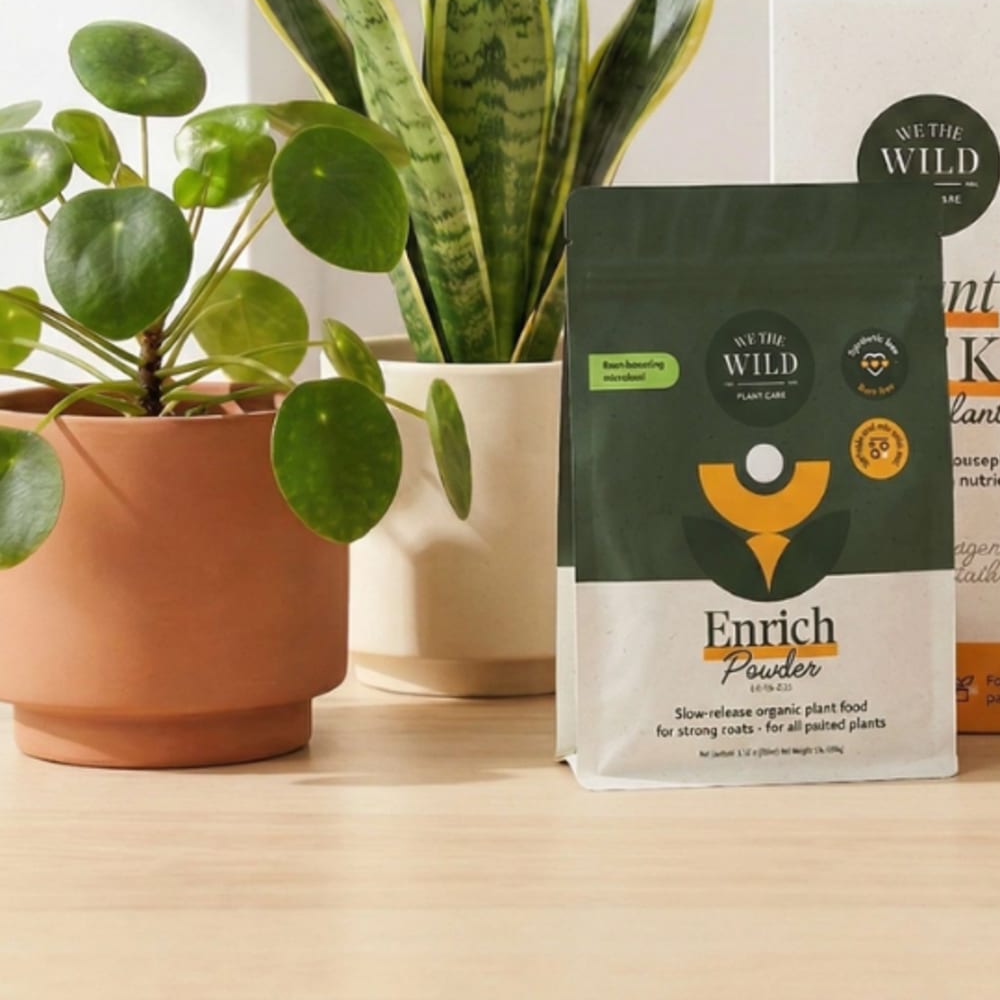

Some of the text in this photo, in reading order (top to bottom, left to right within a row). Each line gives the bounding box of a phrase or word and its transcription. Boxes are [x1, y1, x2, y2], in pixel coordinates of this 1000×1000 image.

[895, 121, 964, 142] WE THE
[880, 146, 980, 175] WILD
[758, 331, 787, 348] THE
[723, 352, 799, 376] WILD
[736, 390, 787, 401] PLANT CARE
[704, 605, 836, 649] Enrich
[720, 648, 822, 685] Powder
[674, 699, 868, 721] Slow-release organic plant food
[656, 725, 674, 738] for
[677, 725, 718, 740] strong
[766, 720, 785, 733] for
[787, 719, 802, 733] all
[849, 716, 887, 733] plants
